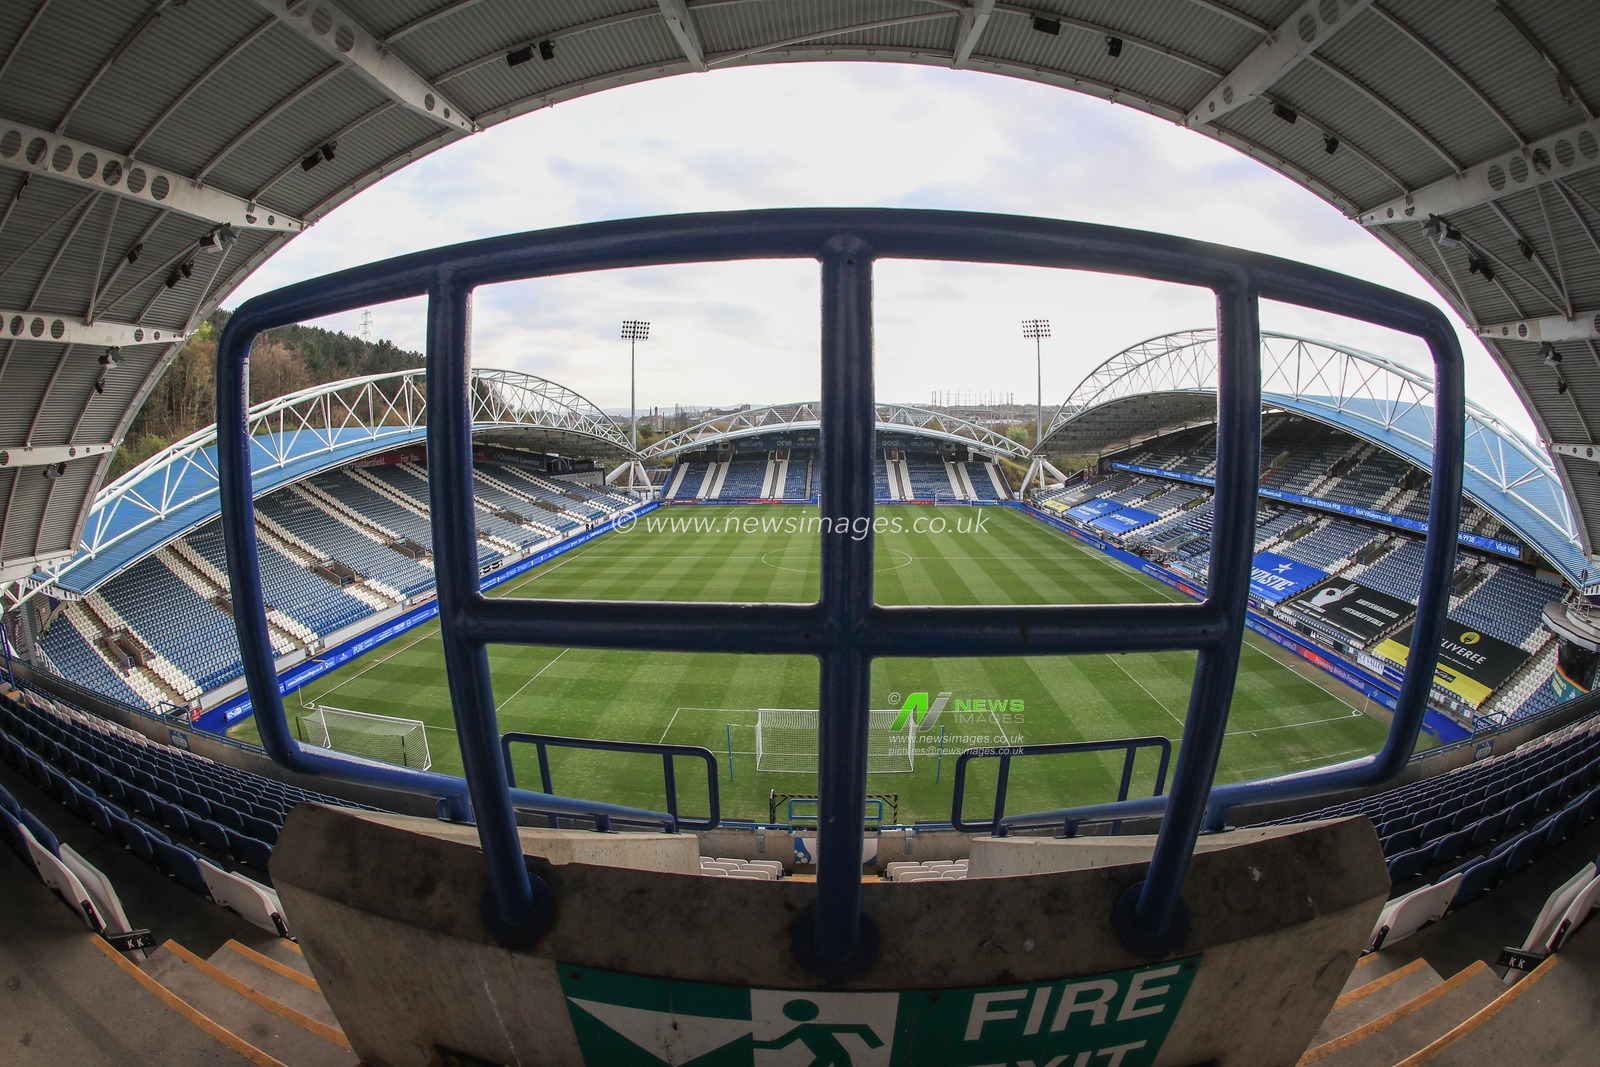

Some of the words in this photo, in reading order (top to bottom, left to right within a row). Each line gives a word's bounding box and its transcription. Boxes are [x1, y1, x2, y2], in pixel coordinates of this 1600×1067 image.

[1495, 542, 1507, 553] Visit
[1442, 638, 1487, 664] LIVEREE
[1314, 656, 1334, 673] Powering
[963, 964, 1181, 1041] FIRE
